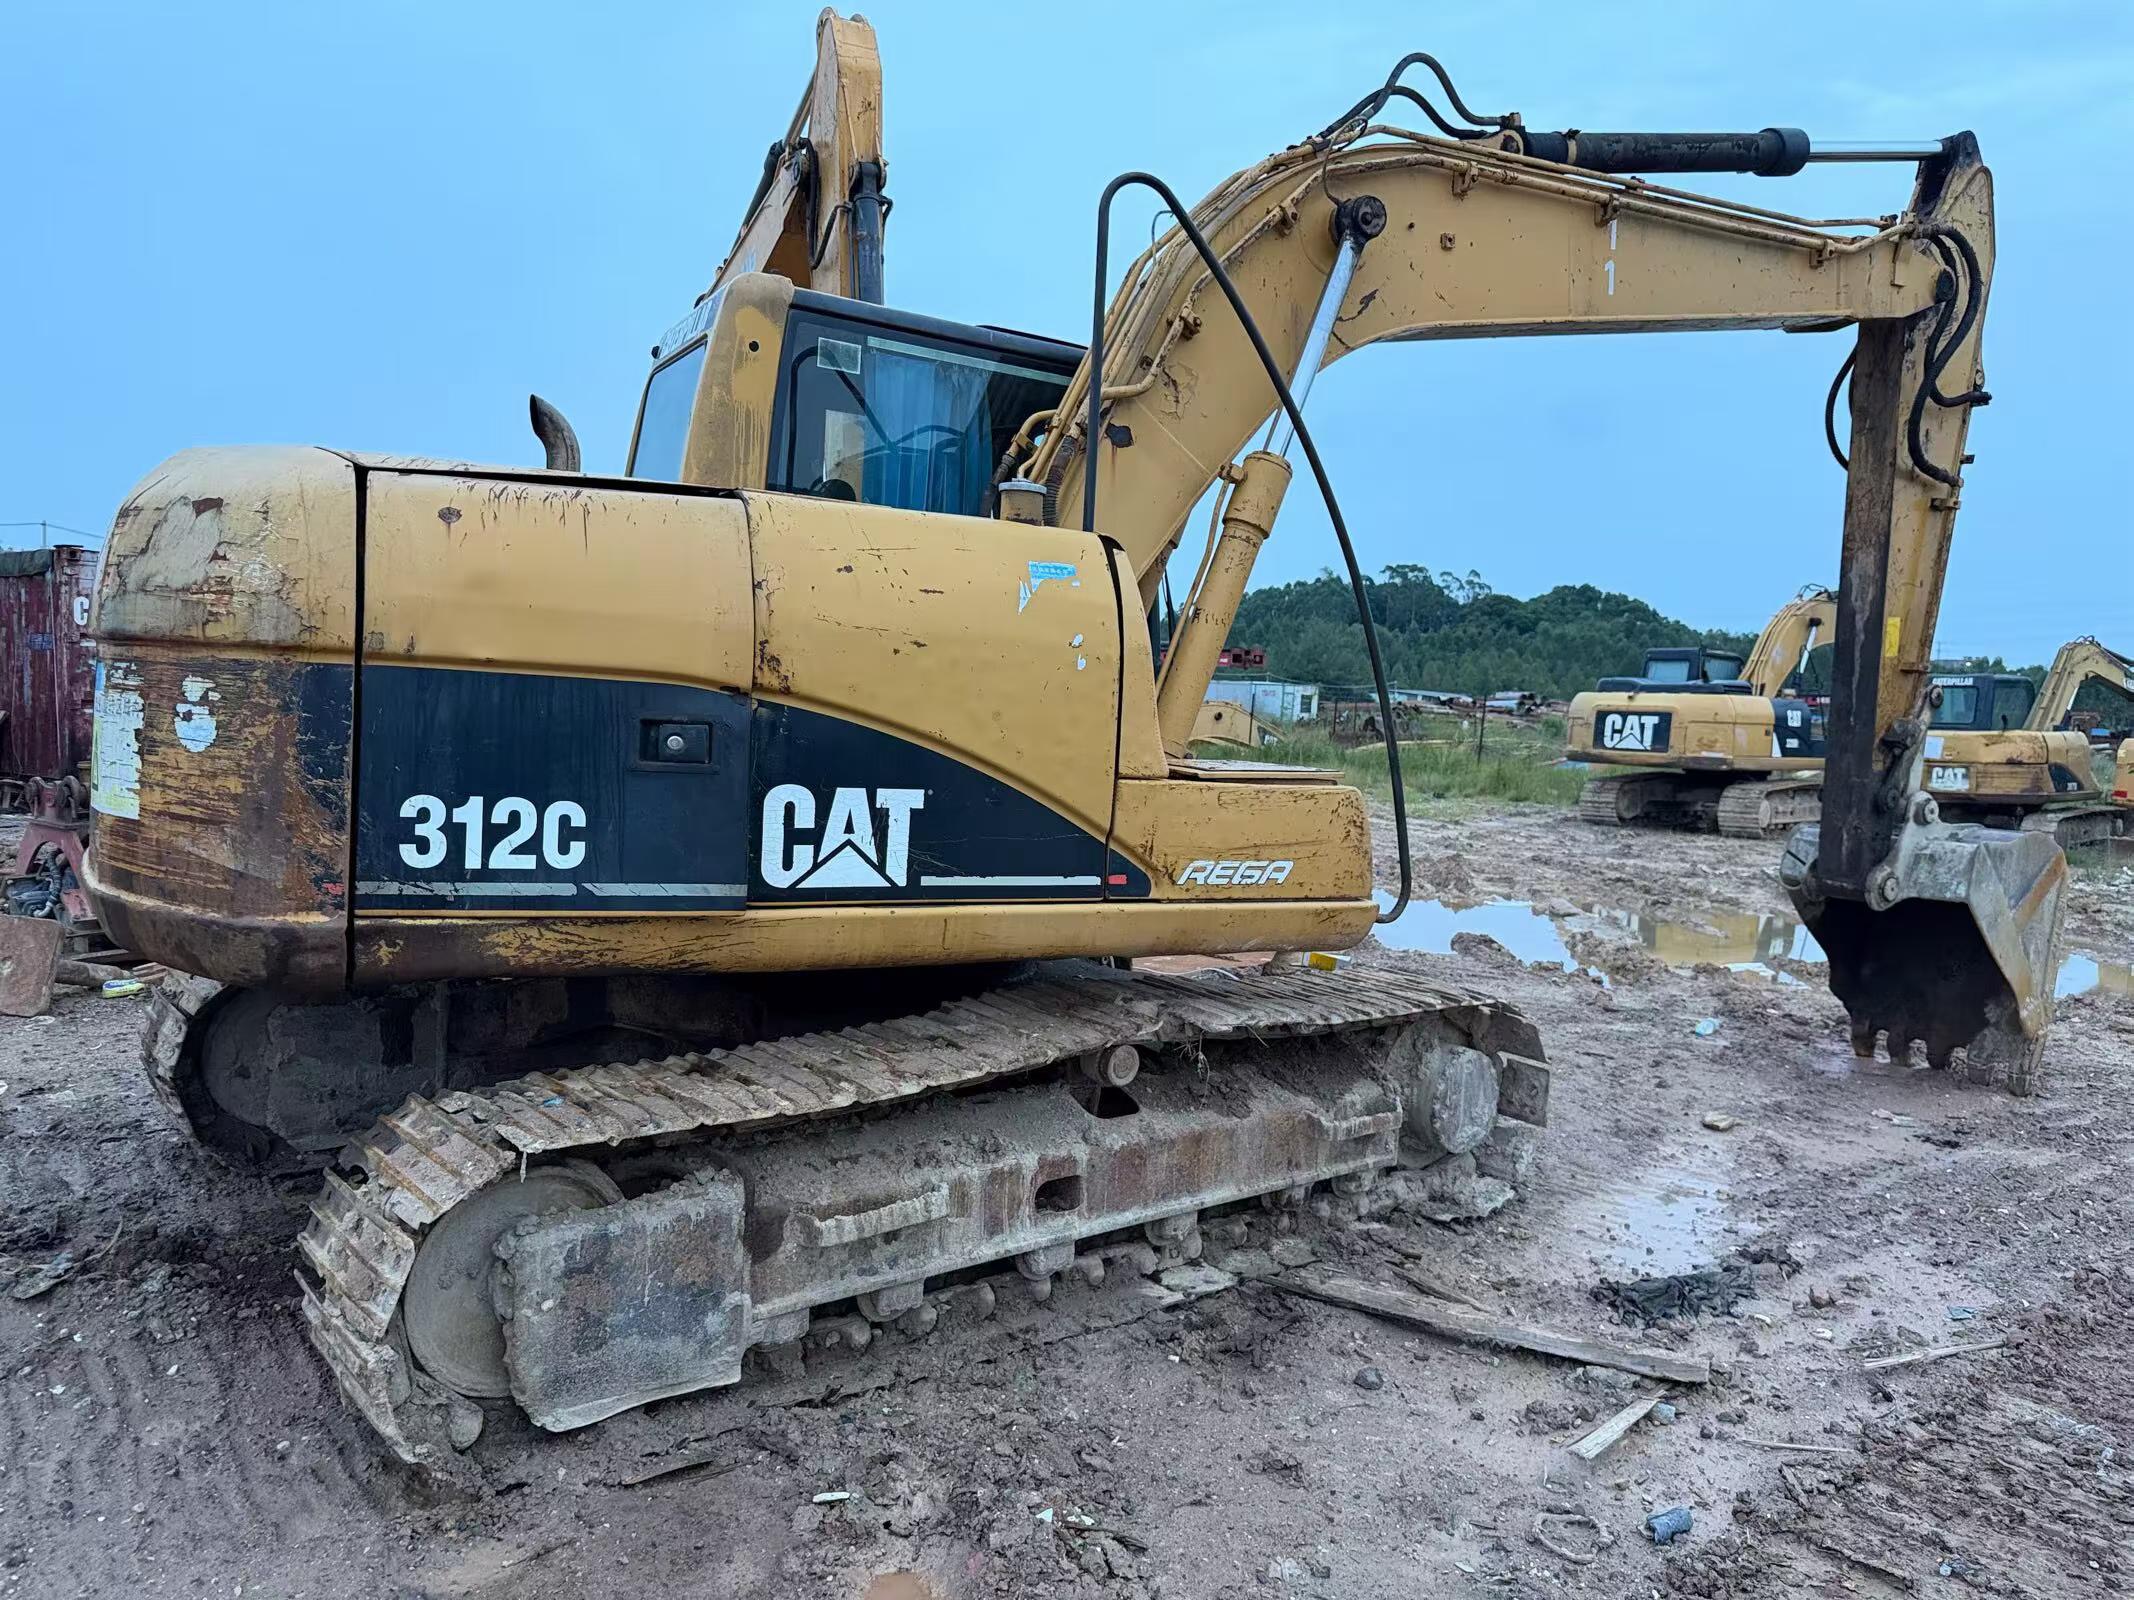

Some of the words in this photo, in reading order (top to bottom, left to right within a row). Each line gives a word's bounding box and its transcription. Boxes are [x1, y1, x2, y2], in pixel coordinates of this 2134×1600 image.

[1603, 713, 1660, 751] CAT
[1931, 766, 1968, 790] CAT
[398, 795, 587, 870] 312C
[760, 783, 925, 889] CAT
[1176, 859, 1295, 886] REGA
